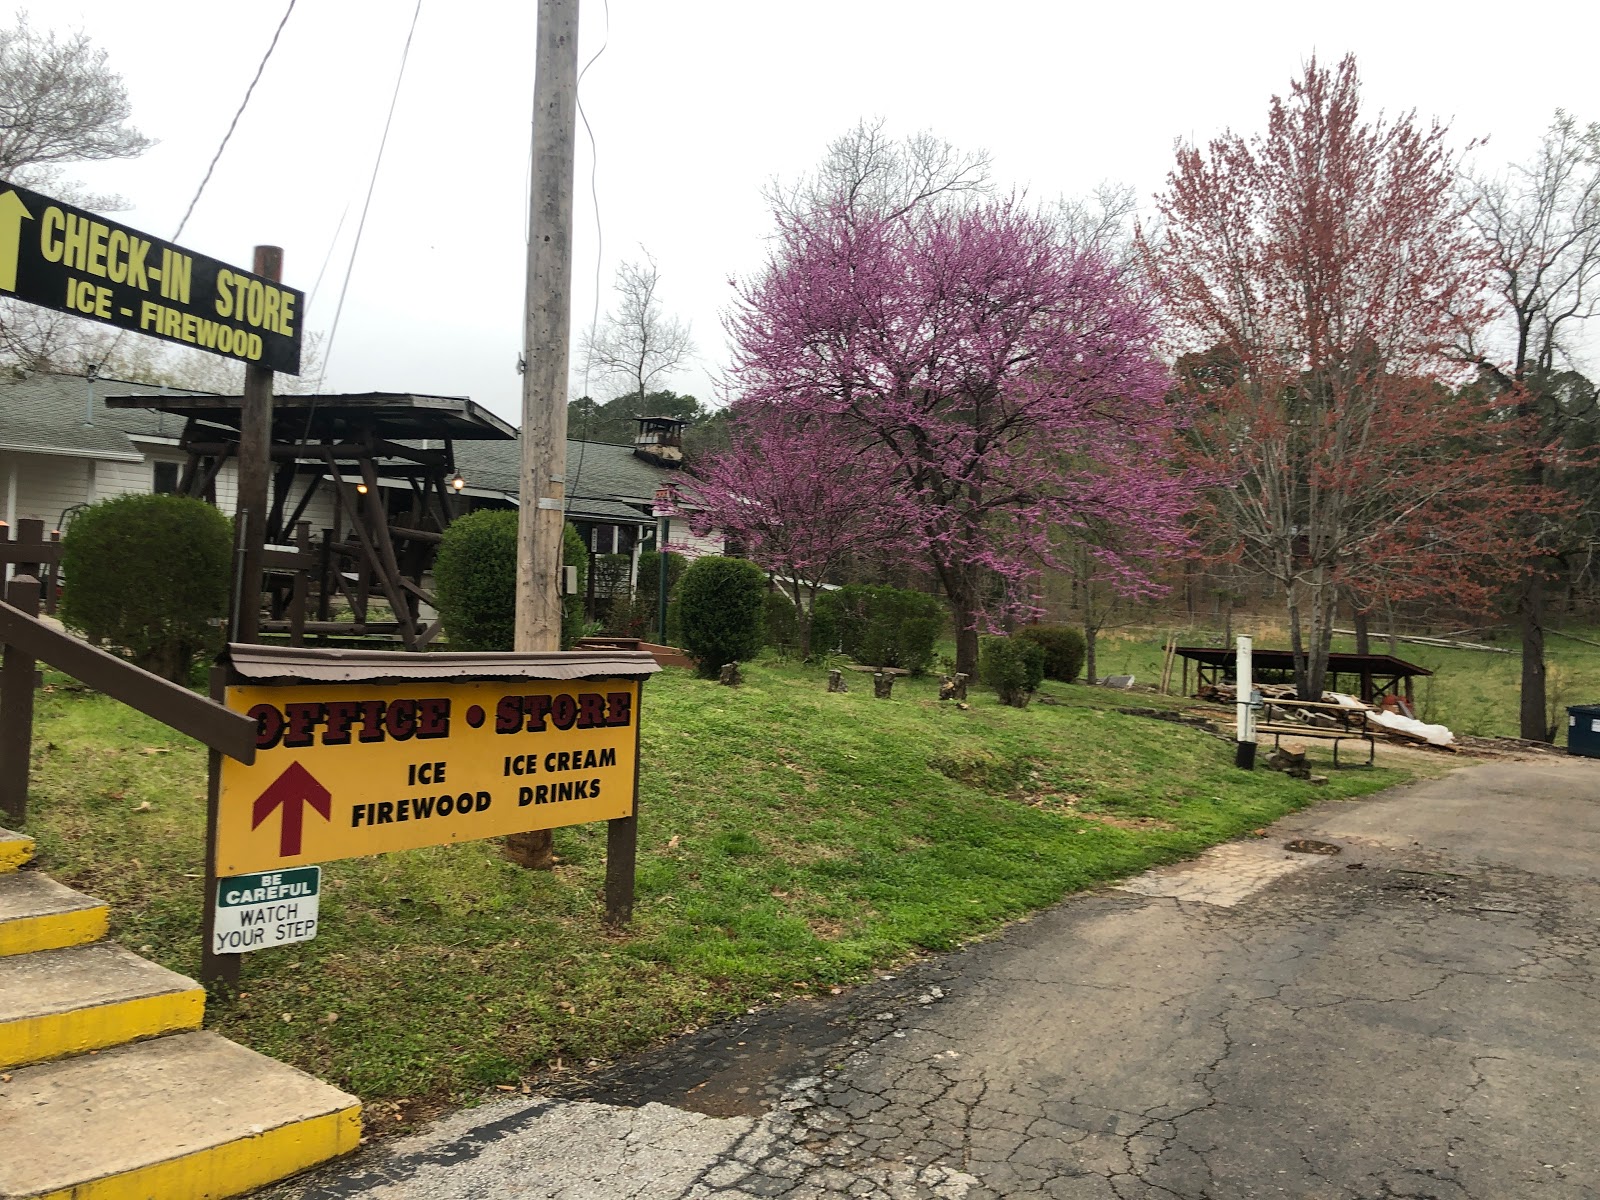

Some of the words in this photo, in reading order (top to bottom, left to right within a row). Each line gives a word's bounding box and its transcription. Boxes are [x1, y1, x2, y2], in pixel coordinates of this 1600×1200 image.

[40, 206, 192, 305] CHECK-IN
[215, 268, 296, 337] STORE
[66, 277, 114, 319] ICE
[140, 300, 263, 361] FIREWOOD
[247, 698, 451, 750] OFFICE
[495, 692, 632, 734] STORE
[408, 762, 447, 786] ICE
[503, 754, 538, 776] ICE
[544, 748, 616, 772] CREAM
[518, 778, 601, 807] DRINKS
[351, 791, 492, 828] FIREWOOD
[226, 882, 311, 904] CAREFUL
[261, 874, 282, 887] BE
[240, 903, 297, 927] WATCH
[217, 928, 264, 950] YOUR
